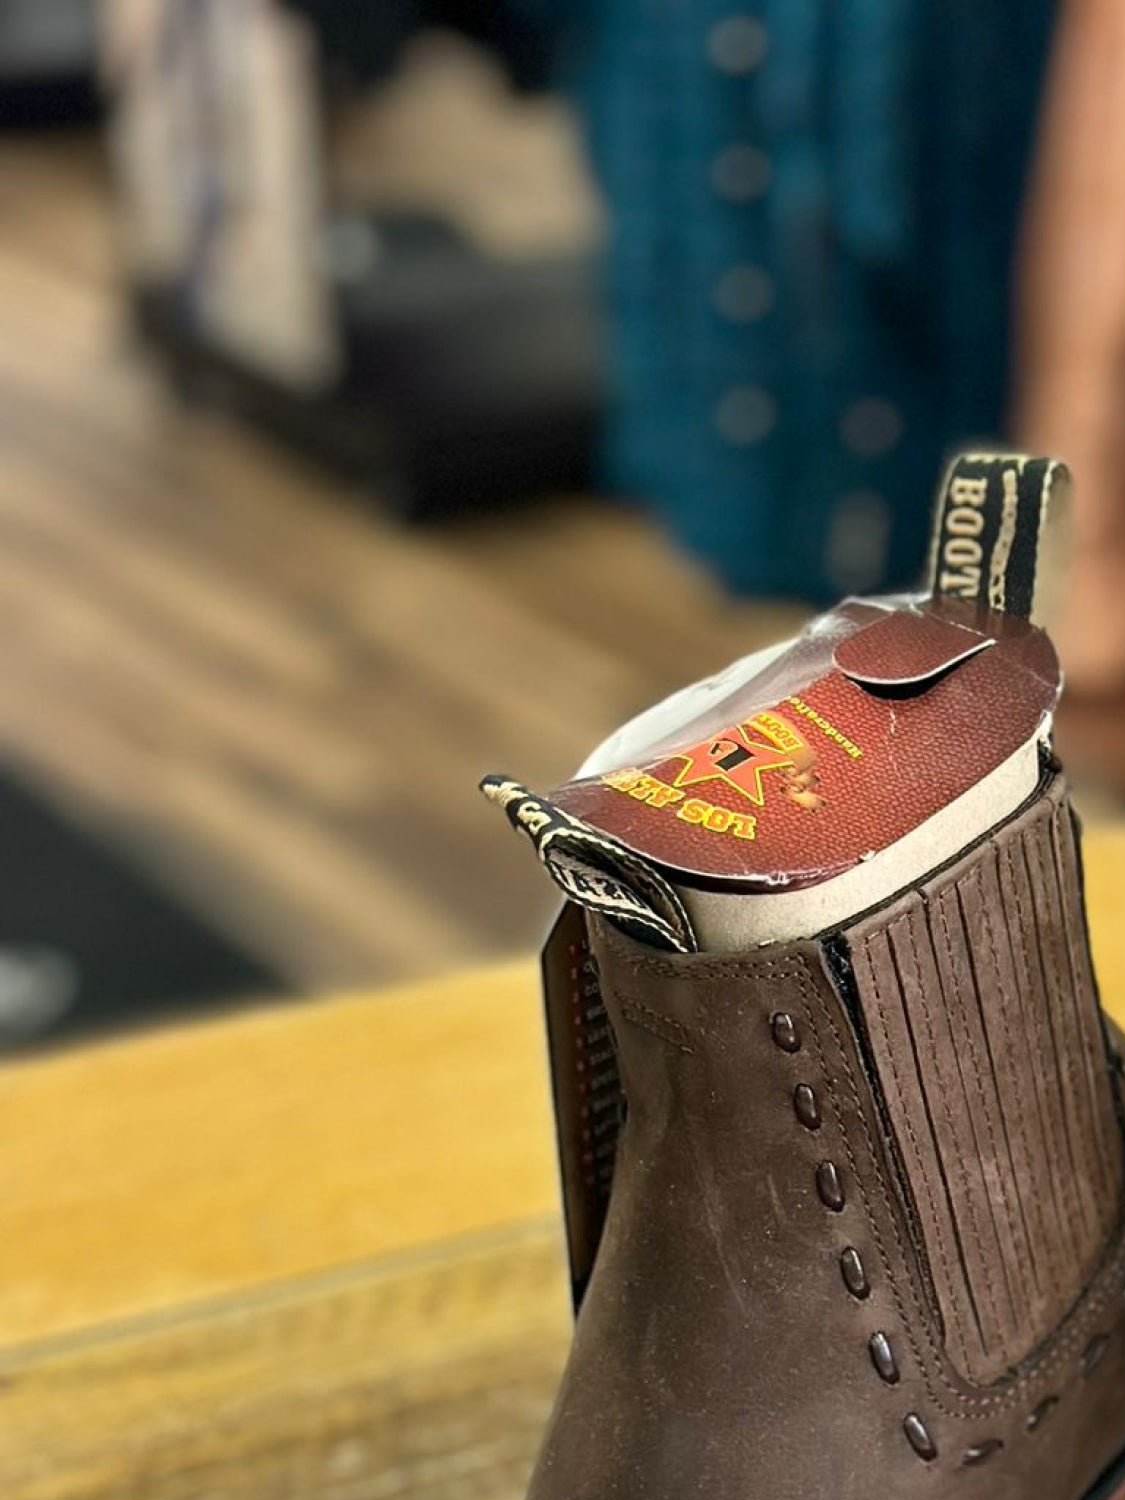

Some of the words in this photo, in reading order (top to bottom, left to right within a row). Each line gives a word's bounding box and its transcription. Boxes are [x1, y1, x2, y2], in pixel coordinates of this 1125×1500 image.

[940, 477, 988, 598] BOOT
[790, 696, 863, 759] Handcrafte
[677, 799, 756, 840] LOS
